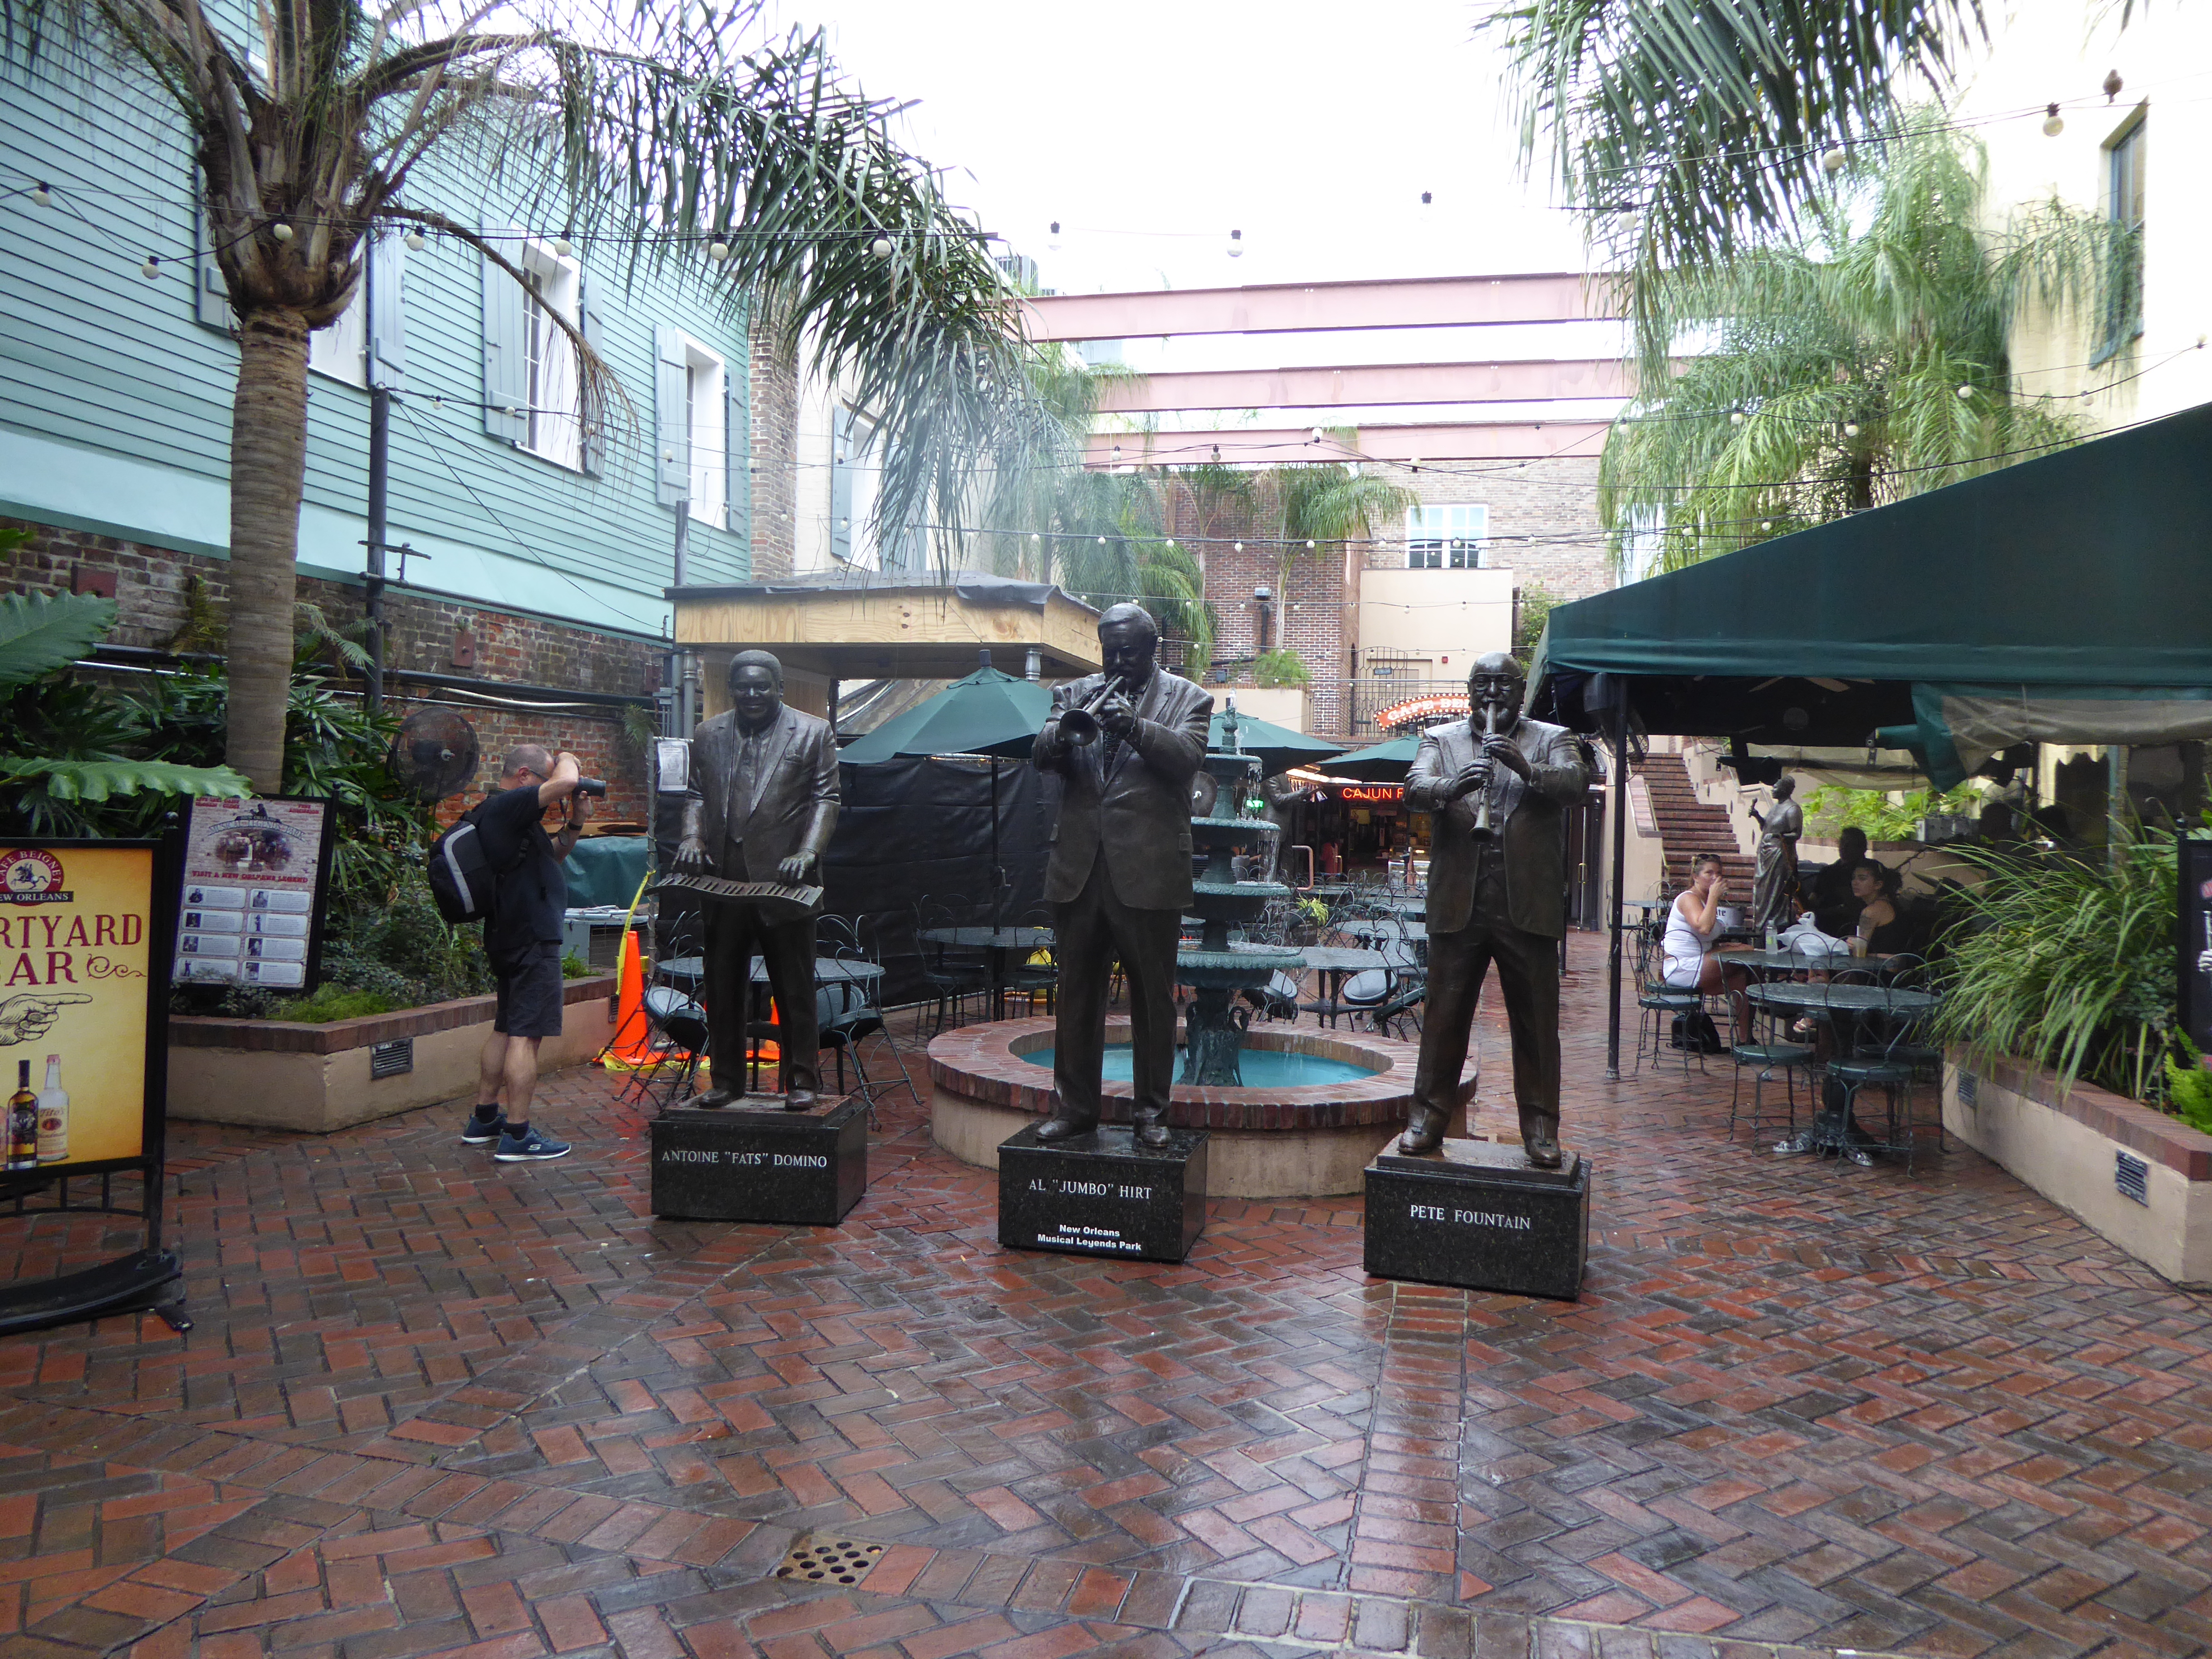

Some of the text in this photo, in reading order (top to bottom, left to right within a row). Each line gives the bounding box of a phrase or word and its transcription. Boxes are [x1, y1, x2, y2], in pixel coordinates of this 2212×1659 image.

[1387, 700, 1434, 721] CAFE
[1343, 787, 1392, 798] CAJUN
[19, 850, 61, 884] BEIGNET
[17, 893, 69, 901] ORLEANS
[662, 1150, 828, 1167] ANTOINE "FATS" DOMINO
[1029, 1179, 1152, 1200] AL "JUMBO" HIRT
[1410, 1204, 1531, 1230] PETE FOUNTAIN
[1059, 1224, 1120, 1237] New Orleans
[1038, 1233, 1142, 1251] Musical Legends Park
